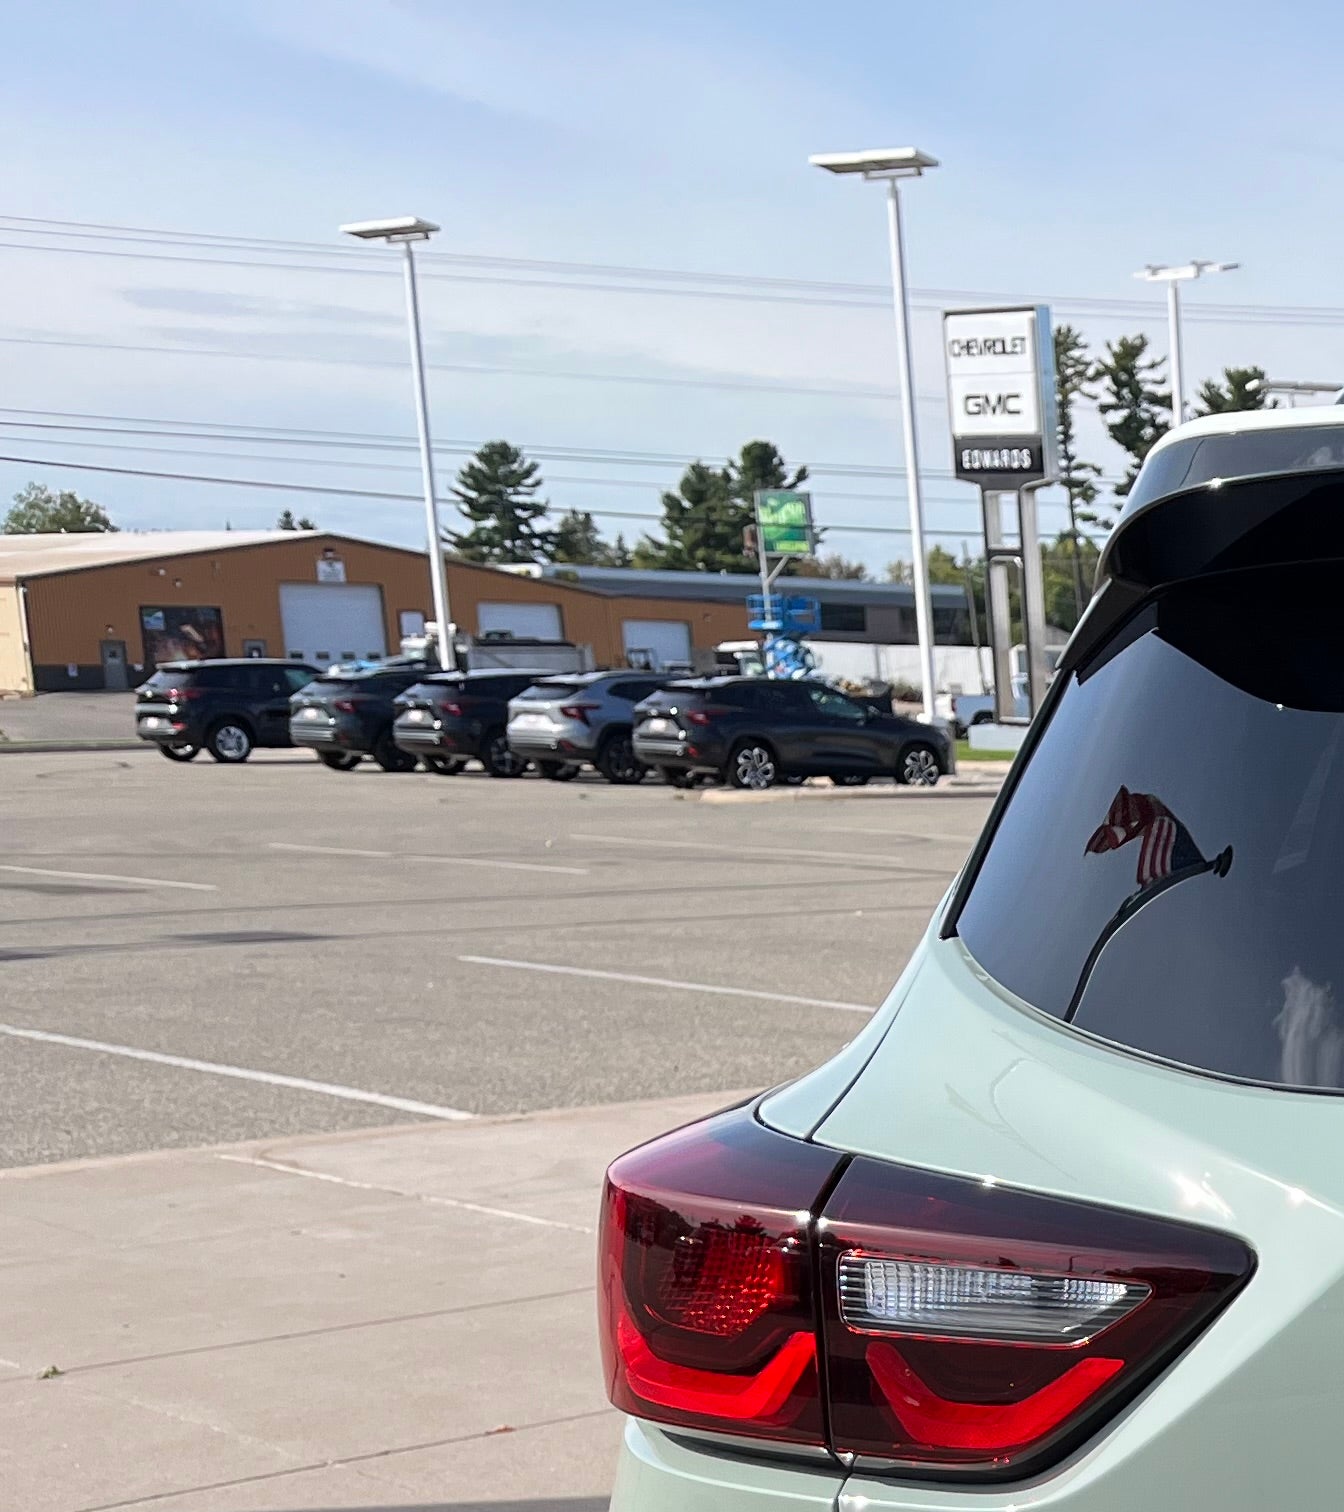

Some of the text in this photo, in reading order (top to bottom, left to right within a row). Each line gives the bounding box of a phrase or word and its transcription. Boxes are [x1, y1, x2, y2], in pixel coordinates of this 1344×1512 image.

[949, 336, 1026, 357] CHEVROLET
[964, 394, 1022, 415] GMC
[961, 448, 1032, 470] EDWARDS
